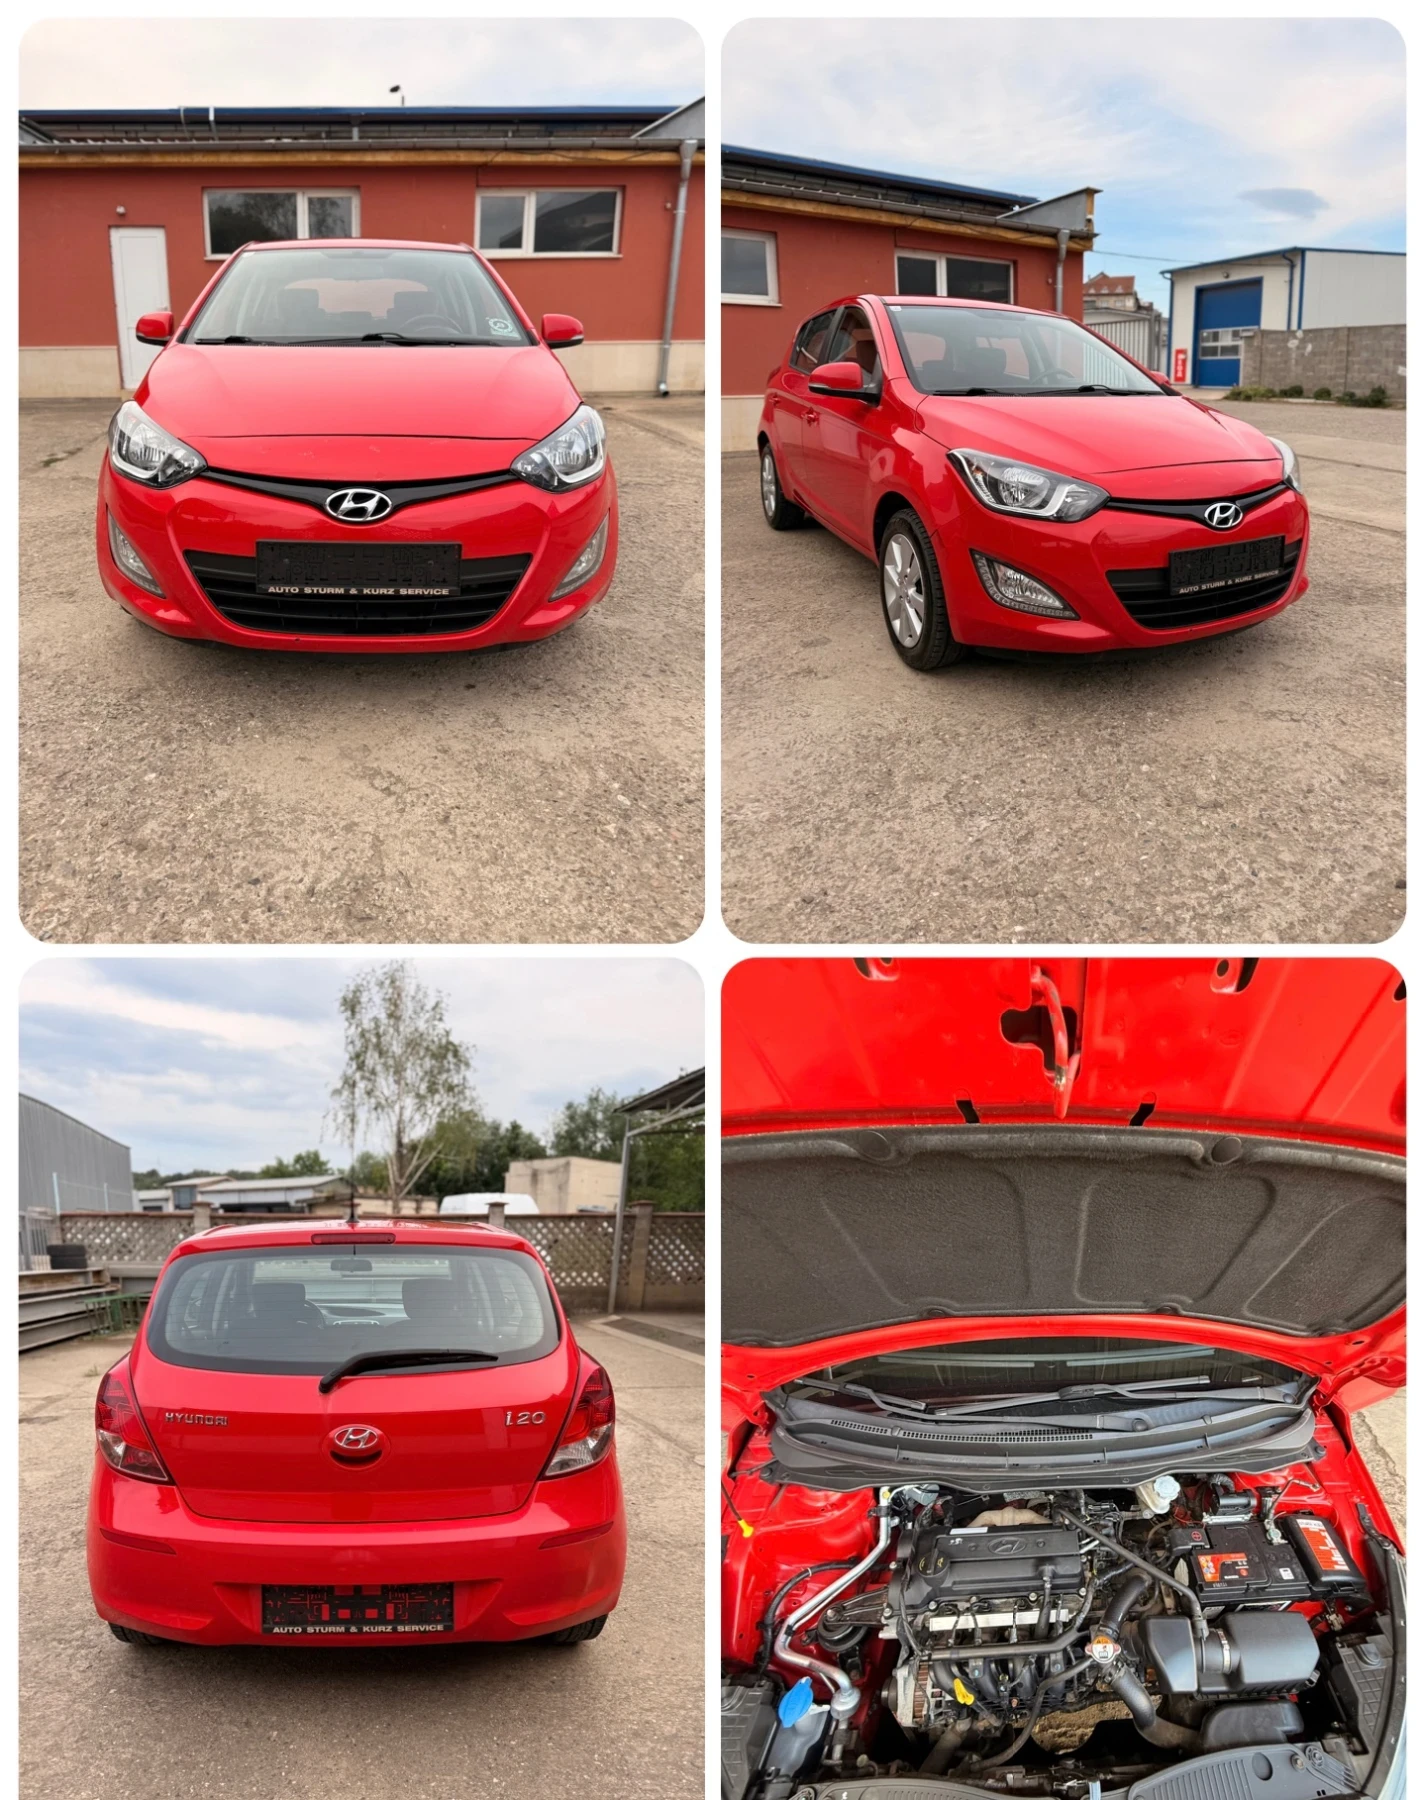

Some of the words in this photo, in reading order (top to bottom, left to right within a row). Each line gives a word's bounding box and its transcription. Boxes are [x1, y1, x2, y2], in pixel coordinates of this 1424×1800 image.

[1179, 586, 1199, 594] AUTO
[1201, 581, 1225, 590] STURM
[1235, 575, 1252, 583] KURZ
[1254, 570, 1279, 579] SERVICE
[268, 586, 299, 594] AUTO
[303, 587, 345, 595] STURM
[165, 1412, 228, 1426] HYUNDAI
[273, 1626, 302, 1634] AUTO
[362, 1625, 393, 1633] KURZ
[397, 1624, 445, 1632] SERVICE
